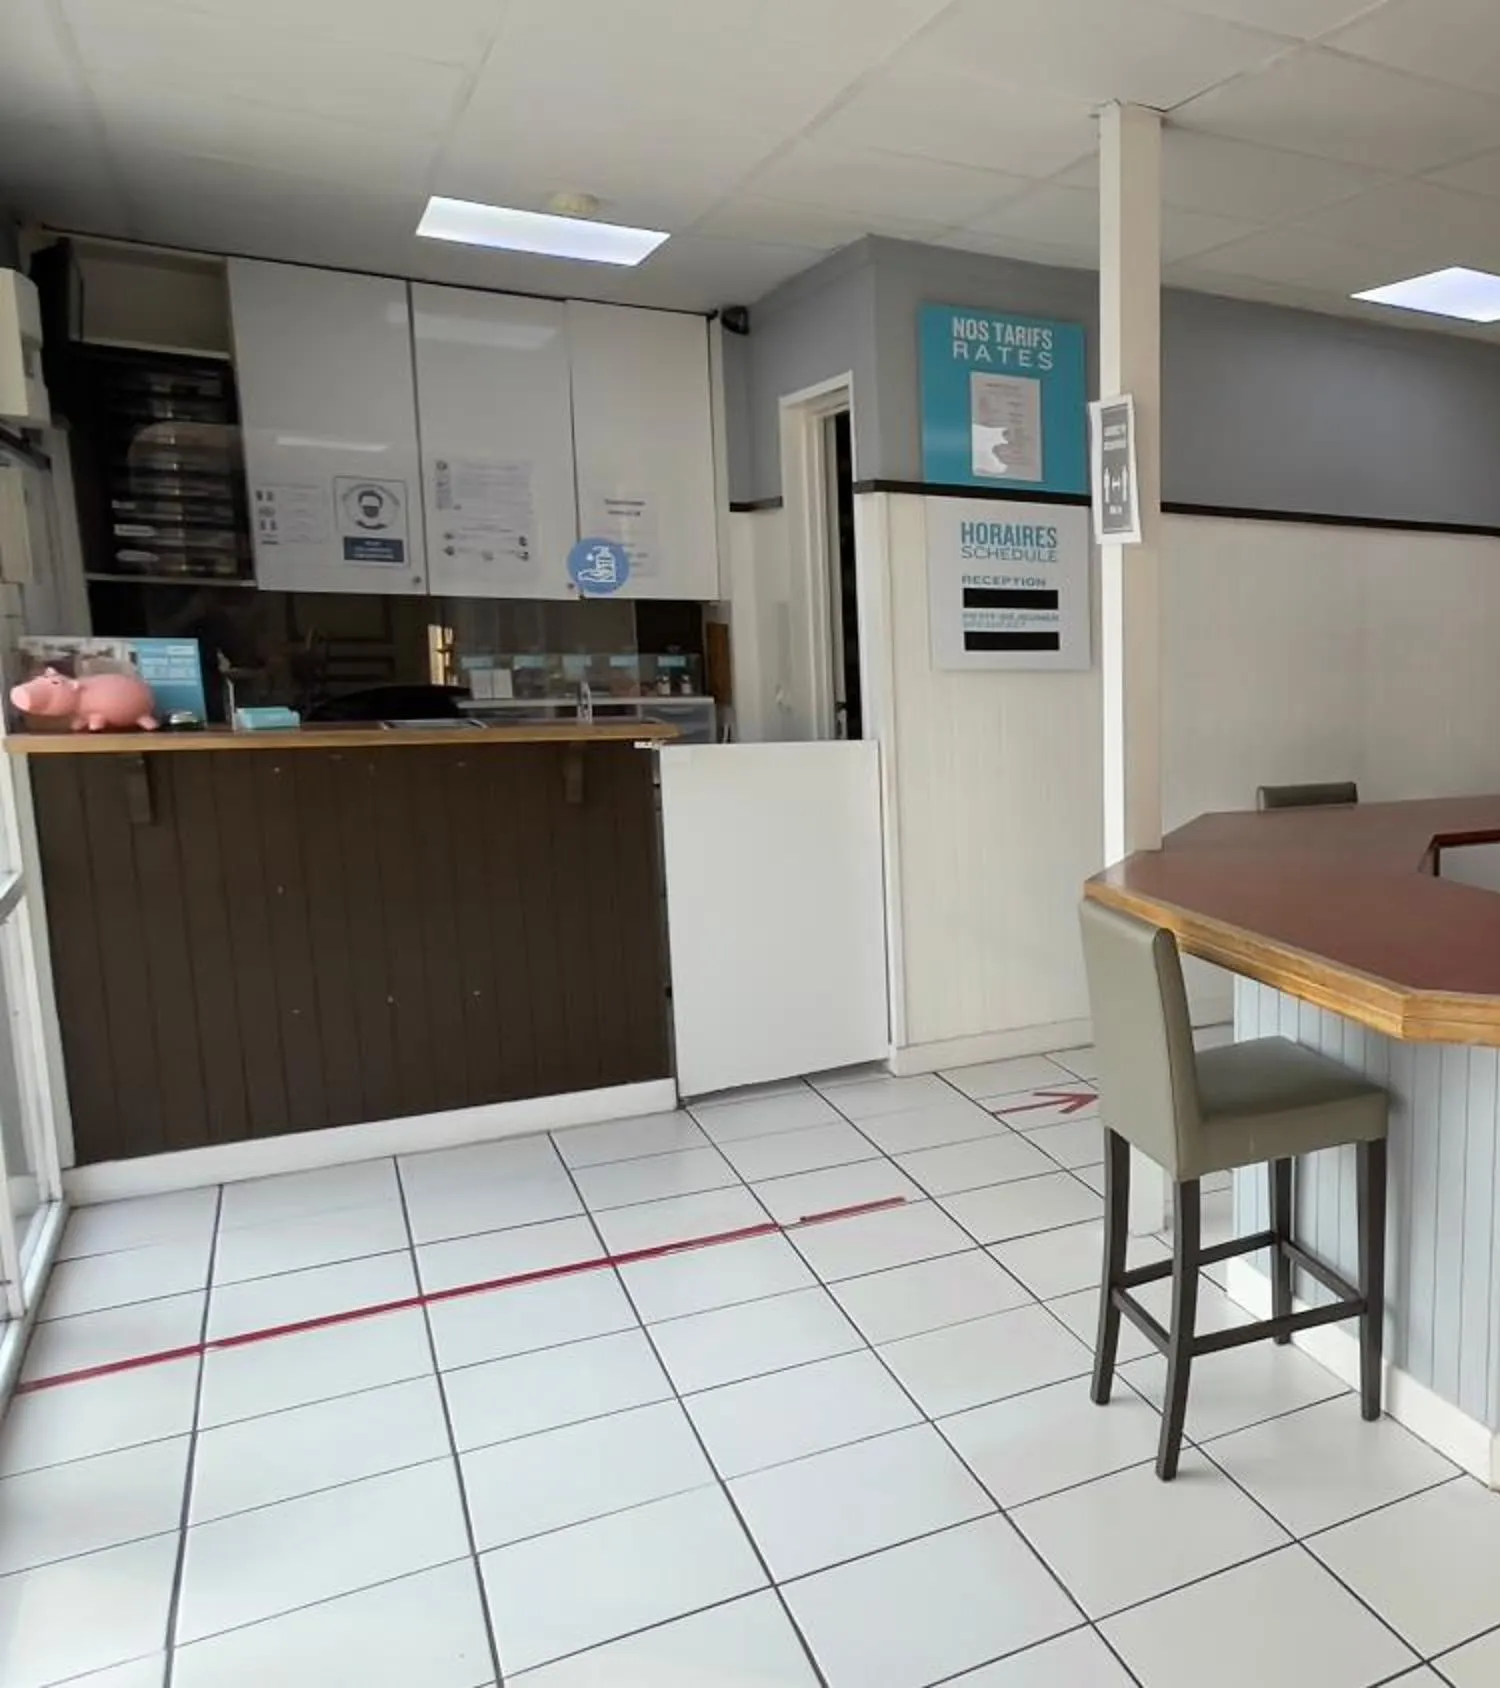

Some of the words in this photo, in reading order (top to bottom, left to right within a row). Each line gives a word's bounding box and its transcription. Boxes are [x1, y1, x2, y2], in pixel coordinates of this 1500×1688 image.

[952, 317, 989, 342] NOS
[992, 321, 1053, 350] TARIFS
[952, 340, 1054, 371] RATES
[961, 521, 1058, 549] HORAIRES
[961, 545, 1058, 563] SCHEDULE
